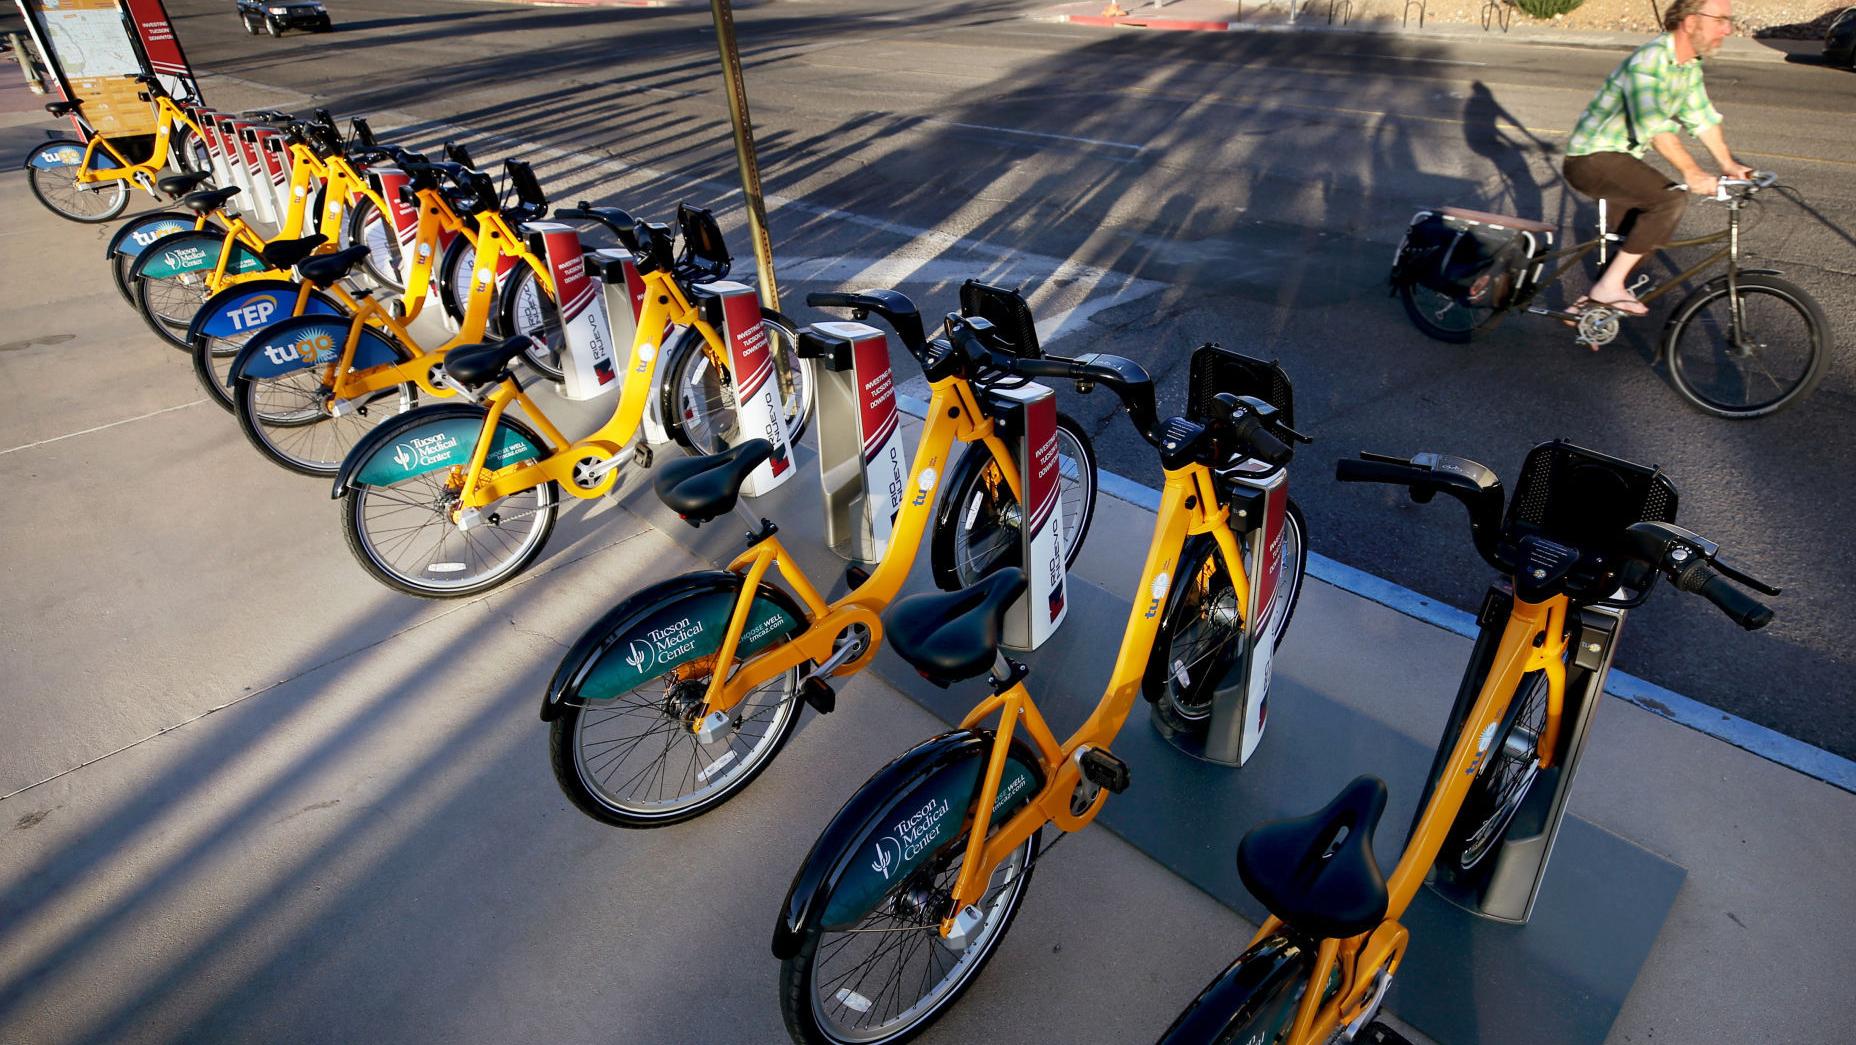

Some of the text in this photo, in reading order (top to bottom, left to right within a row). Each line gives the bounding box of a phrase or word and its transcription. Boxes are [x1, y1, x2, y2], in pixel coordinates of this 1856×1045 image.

[227, 302, 274, 330] TEP
[588, 314, 606, 357] NUEVO
[264, 335, 333, 365] tugo
[589, 340, 600, 360] RIO
[765, 392, 781, 443] NUEVO
[410, 432, 446, 449] Tucson
[418, 437, 457, 457] Medical
[420, 450, 451, 466] Center
[890, 447, 902, 502] NUEVO
[889, 482, 898, 508] RIO
[648, 618, 690, 642] Tucson
[656, 621, 703, 652] Medical
[740, 613, 782, 642] HOOSE WELL
[750, 619, 784, 642] tmcaz.com
[658, 640, 696, 664] Center
[894, 798, 936, 835] Tucson
[902, 799, 949, 847] Medical
[904, 823, 941, 861] Center
